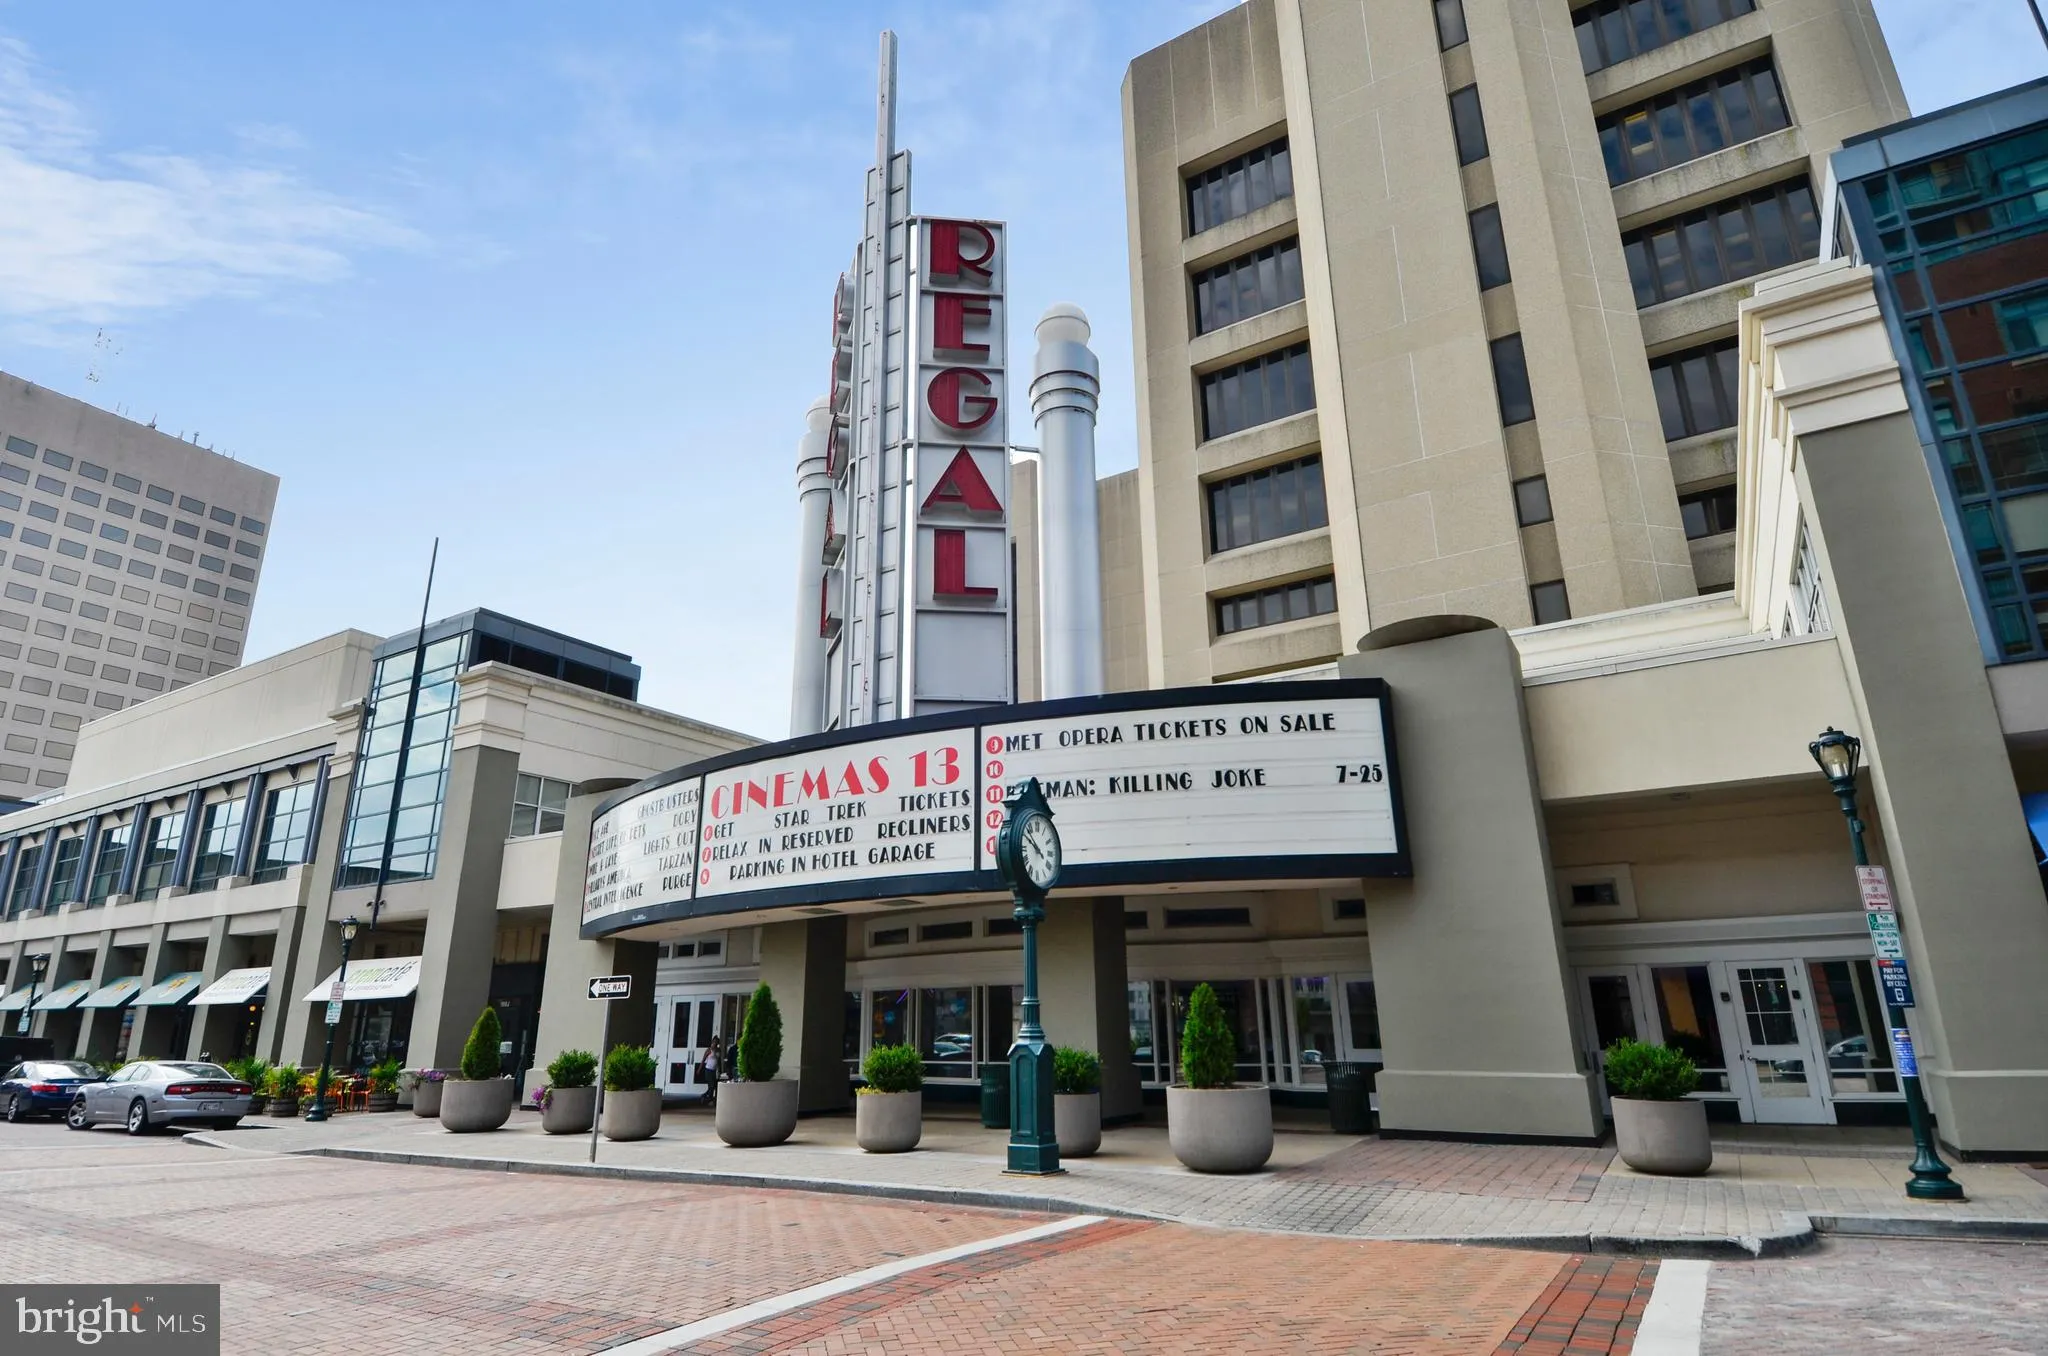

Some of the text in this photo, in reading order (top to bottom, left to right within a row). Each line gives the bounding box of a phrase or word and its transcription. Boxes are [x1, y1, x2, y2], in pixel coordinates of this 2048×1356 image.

[920, 219, 1004, 601] REGAL
[1006, 733, 1043, 752] MET
[1059, 726, 1123, 747] OPERA
[1134, 718, 1226, 741] TICKETS
[1240, 715, 1268, 734] ON
[1280, 713, 1336, 732] SALE
[711, 747, 960, 819] CINEMAS 13
[988, 762, 1001, 777] 10
[988, 786, 1001, 802] 11
[1109, 772, 1193, 794] KILLING
[1211, 768, 1266, 788] JOKE
[1336, 764, 1383, 783] 7-25
[673, 809, 697, 828] DORY
[714, 822, 734, 839] GET
[774, 809, 809, 829] STAR
[827, 801, 867, 821] TREK
[898, 789, 970, 812] TICKETS
[643, 836, 670, 855] LIGHTS
[676, 829, 695, 847] OUT
[712, 841, 748, 861] RELAX
[759, 837, 772, 854] IN
[782, 826, 854, 851] RESERVED
[878, 814, 970, 839] RECLINERS
[659, 851, 693, 872] TARZAN
[730, 858, 784, 881] PARKING
[792, 855, 806, 873] IN
[812, 850, 858, 870] HOTEL
[868, 842, 935, 865] GARAGE
[662, 872, 692, 891] PURGE
[599, 983, 626, 992] ONE WAY
